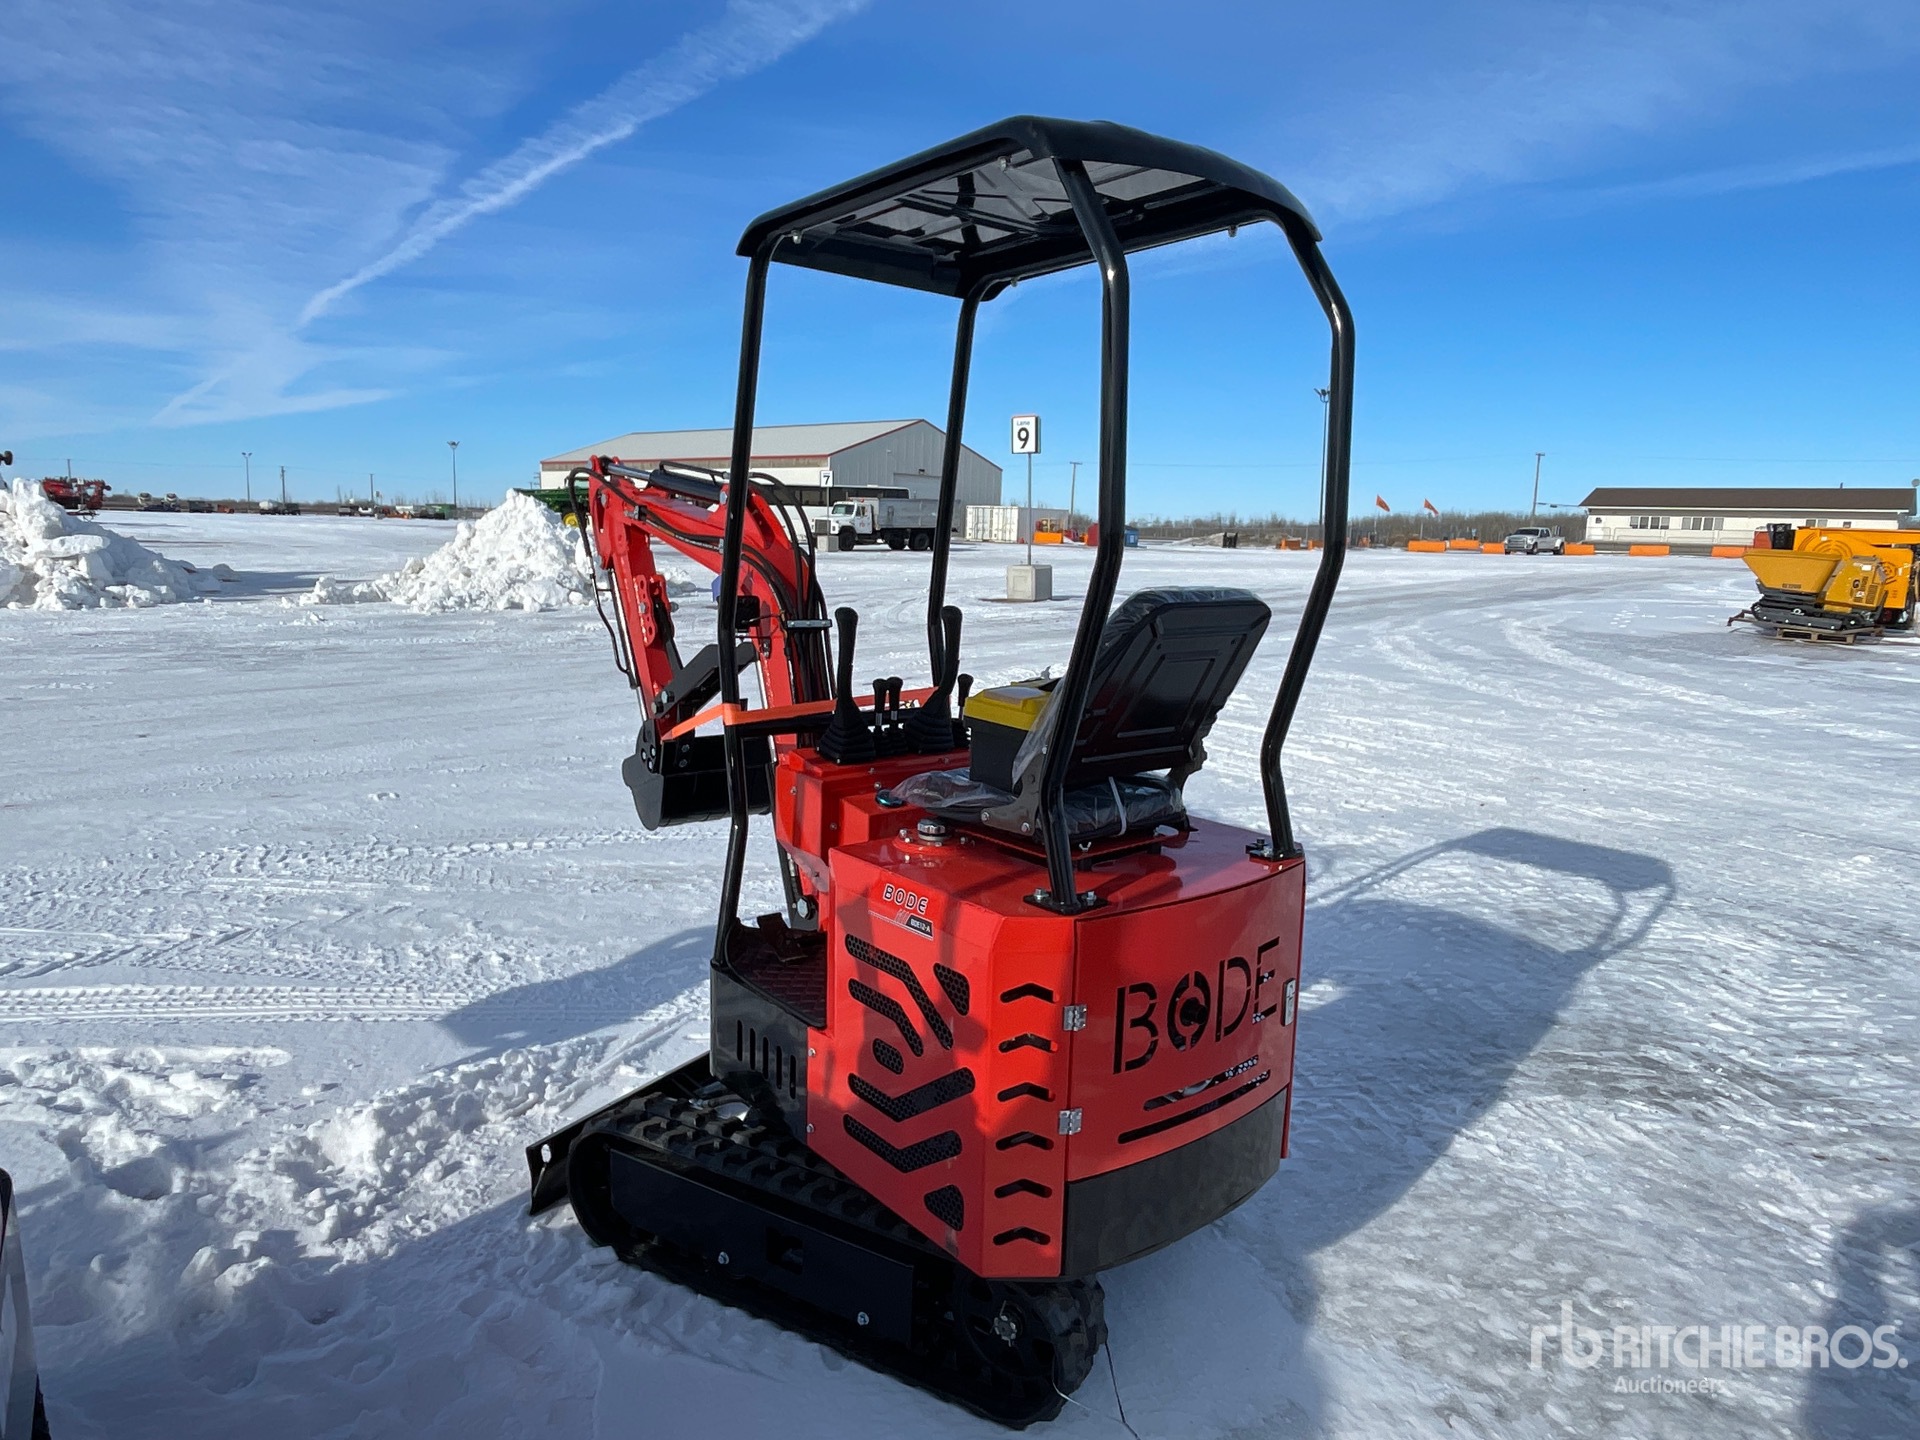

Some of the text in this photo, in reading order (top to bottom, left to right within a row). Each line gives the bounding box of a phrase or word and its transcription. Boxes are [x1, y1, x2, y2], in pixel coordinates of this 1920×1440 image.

[1017, 427, 1029, 449] 9
[823, 475, 830, 485] 7
[883, 883, 929, 914] BODE
[1113, 936, 1281, 1075] BODE
